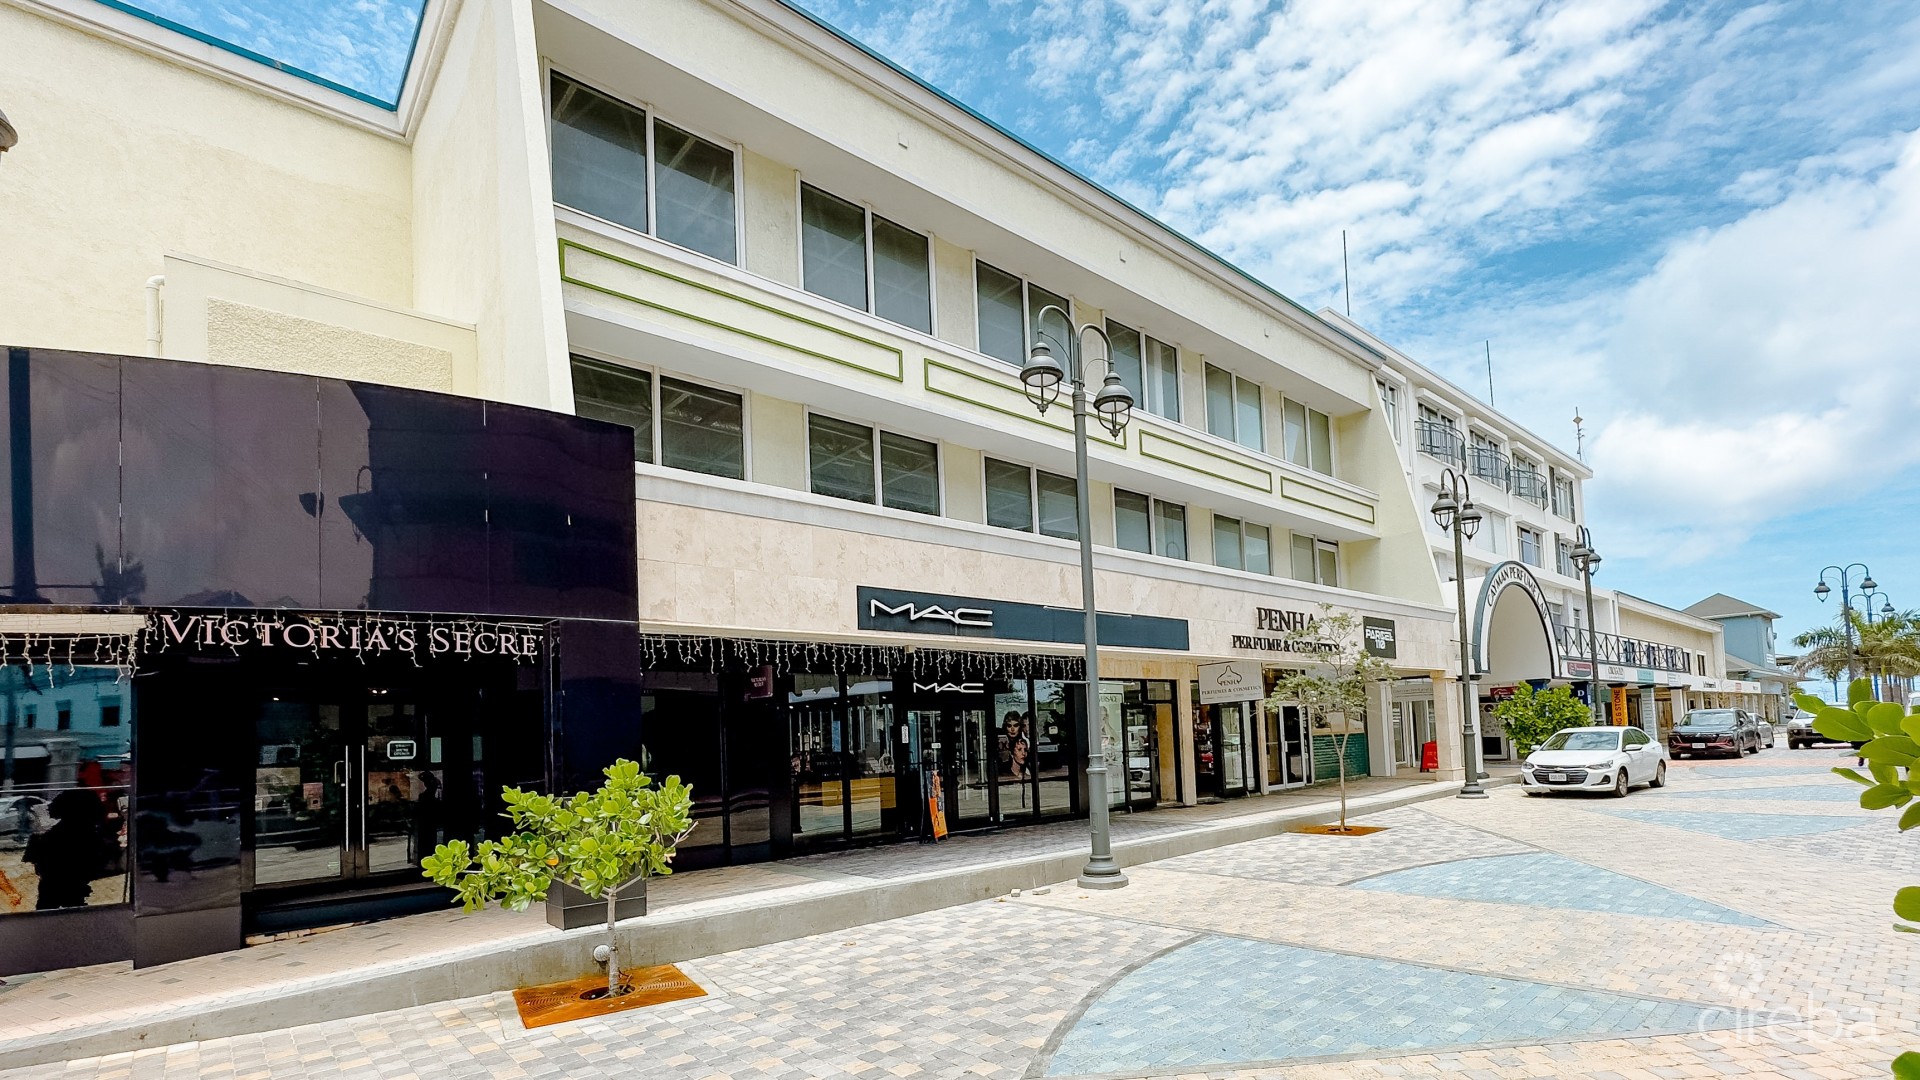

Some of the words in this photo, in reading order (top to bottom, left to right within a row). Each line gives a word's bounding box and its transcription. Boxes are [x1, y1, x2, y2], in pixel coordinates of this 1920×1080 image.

[1487, 567, 1509, 607] CAYMAN
[1509, 566, 1537, 596] PERFUME
[1256, 607, 1317, 632] PENHA
[160, 614, 416, 652] VICTORIA'S
[431, 627, 543, 656] SECRE
[1231, 635, 1283, 652] PERFUME
[1284, 640, 1291, 652] &
[1365, 629, 1395, 641] PARCEL
[1613, 690, 1621, 711] STONE
